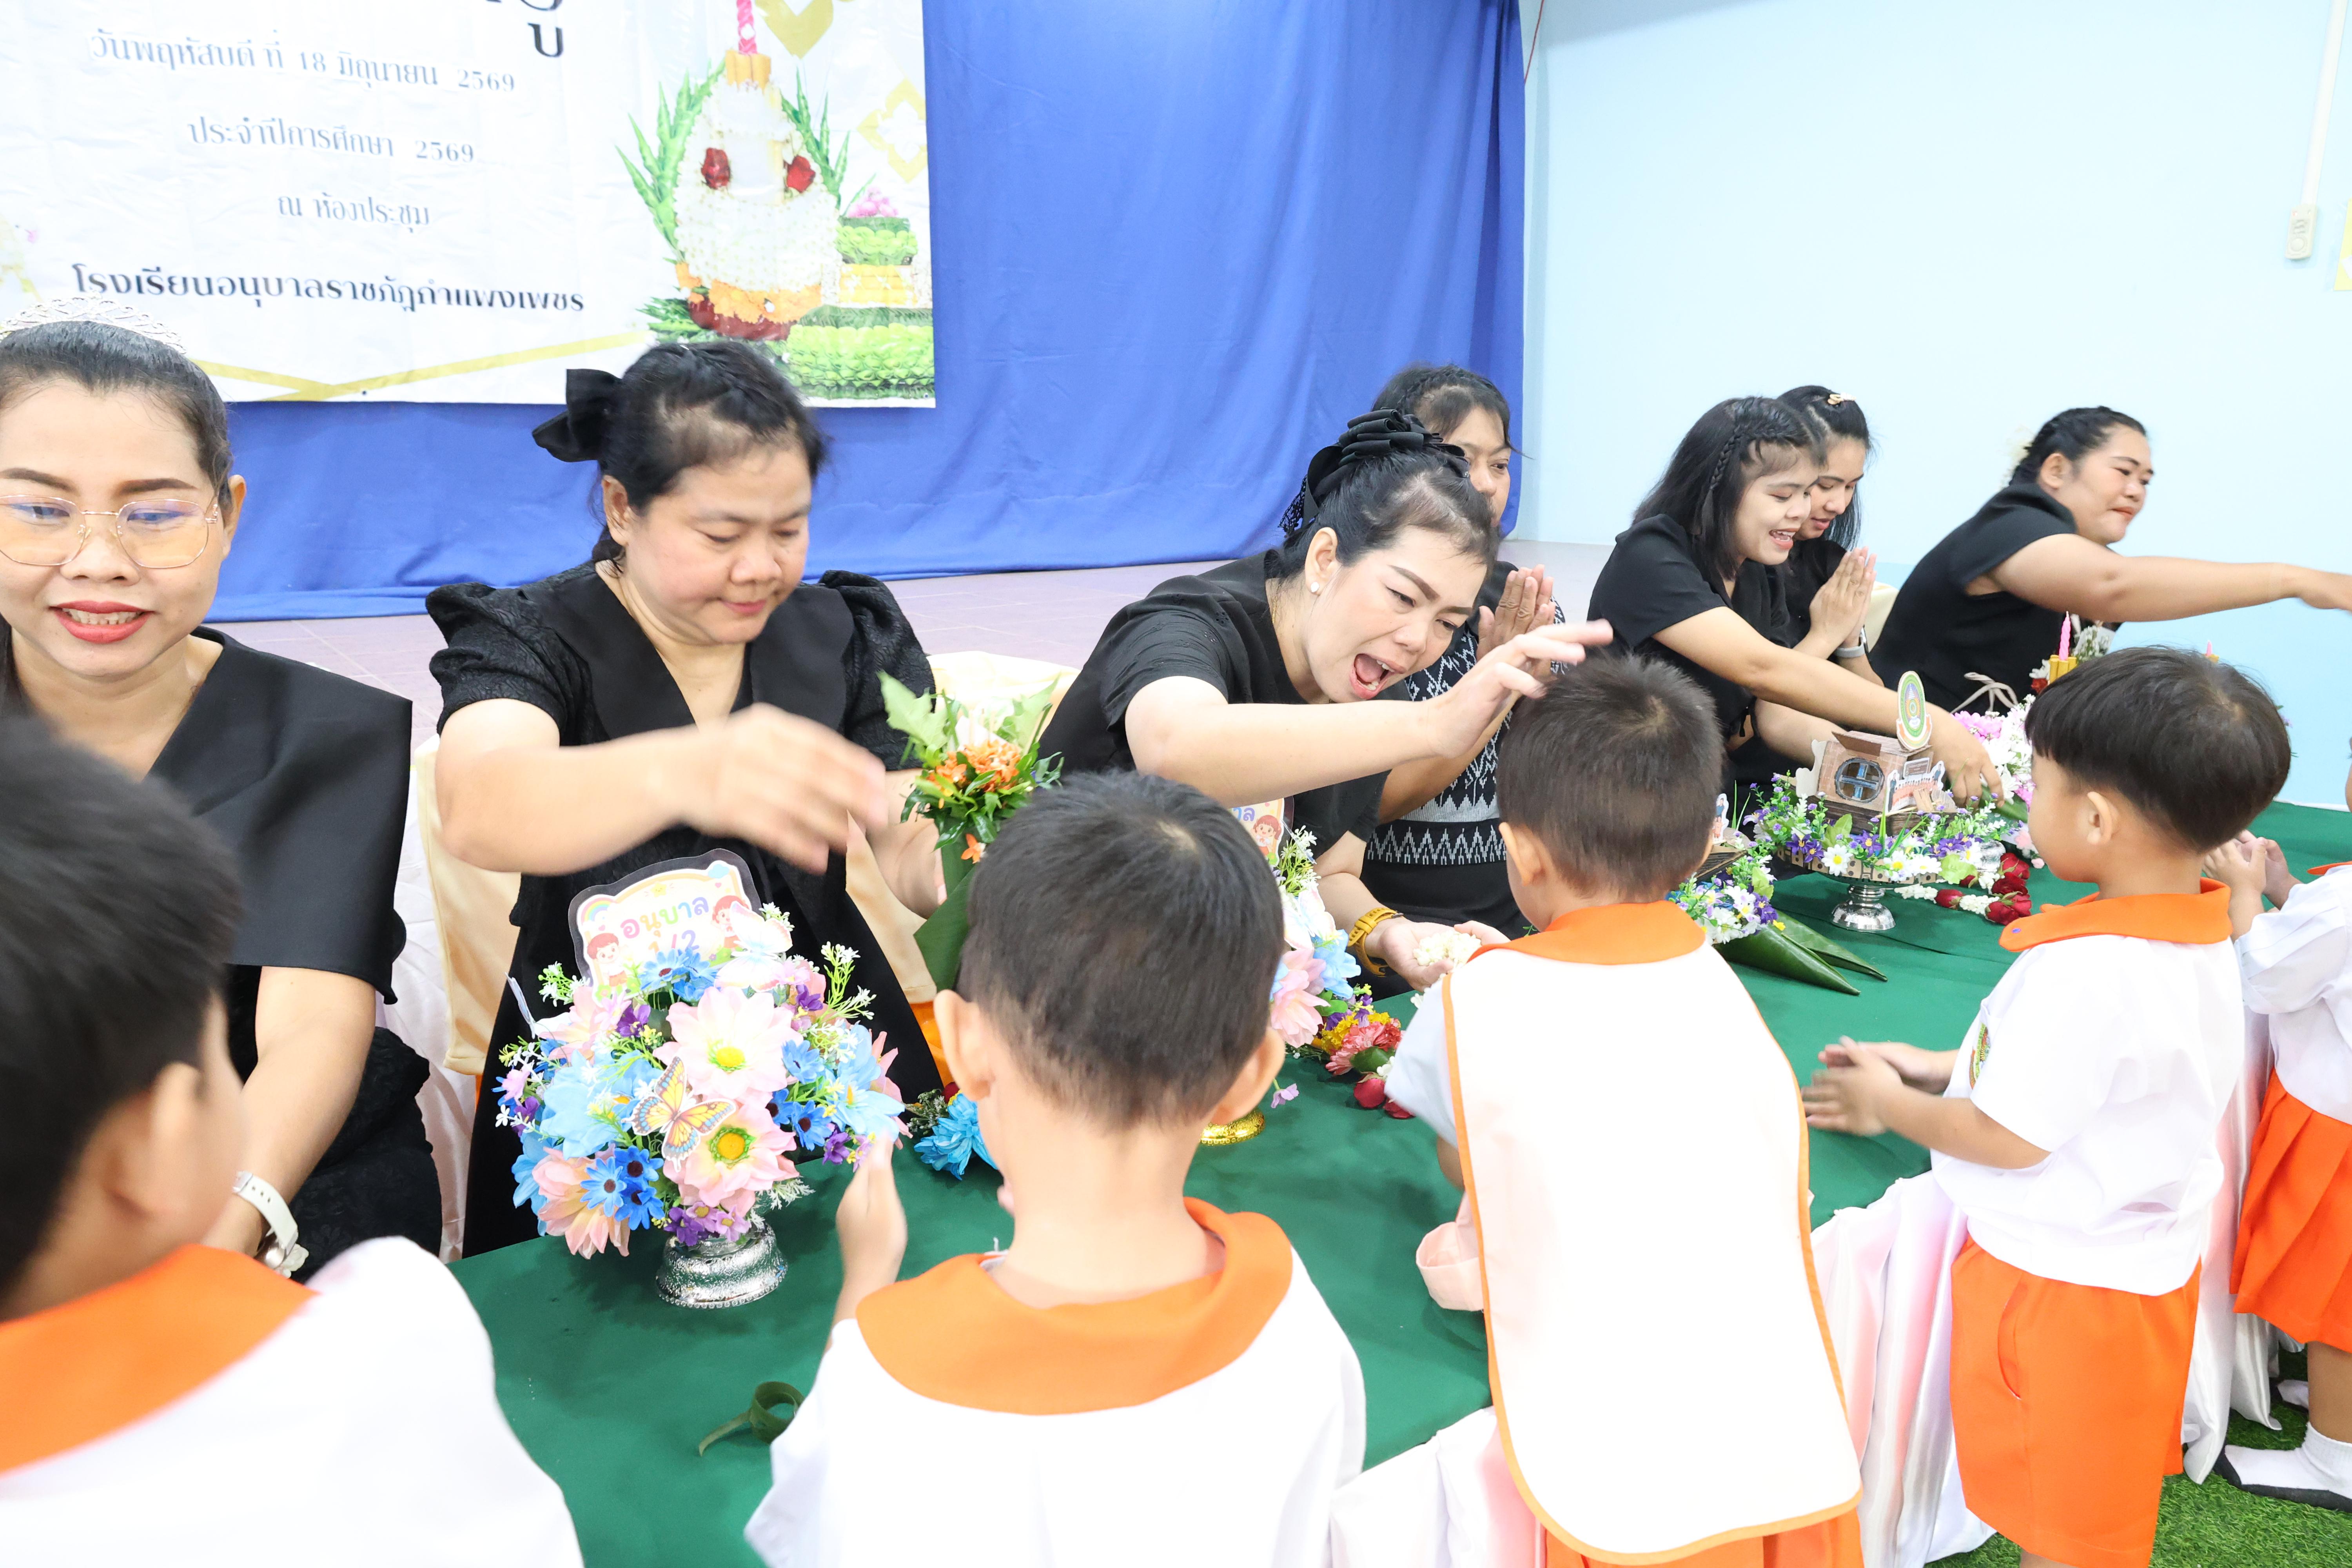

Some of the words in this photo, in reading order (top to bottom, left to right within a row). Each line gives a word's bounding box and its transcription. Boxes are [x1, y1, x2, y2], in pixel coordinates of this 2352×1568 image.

[91, 28, 256, 71] วันพฤหัสบดี
[263, 29, 284, 69] ที่
[299, 51, 327, 73] 18
[336, 50, 439, 89] มิถุนายน
[457, 69, 515, 92] 2569
[187, 116, 394, 157] ประจำปีการศึกษา
[415, 140, 474, 163] 2569
[277, 196, 303, 217] ณ
[312, 192, 430, 234] ห้องประชุม
[620, 897, 709, 939] อนุบาล
